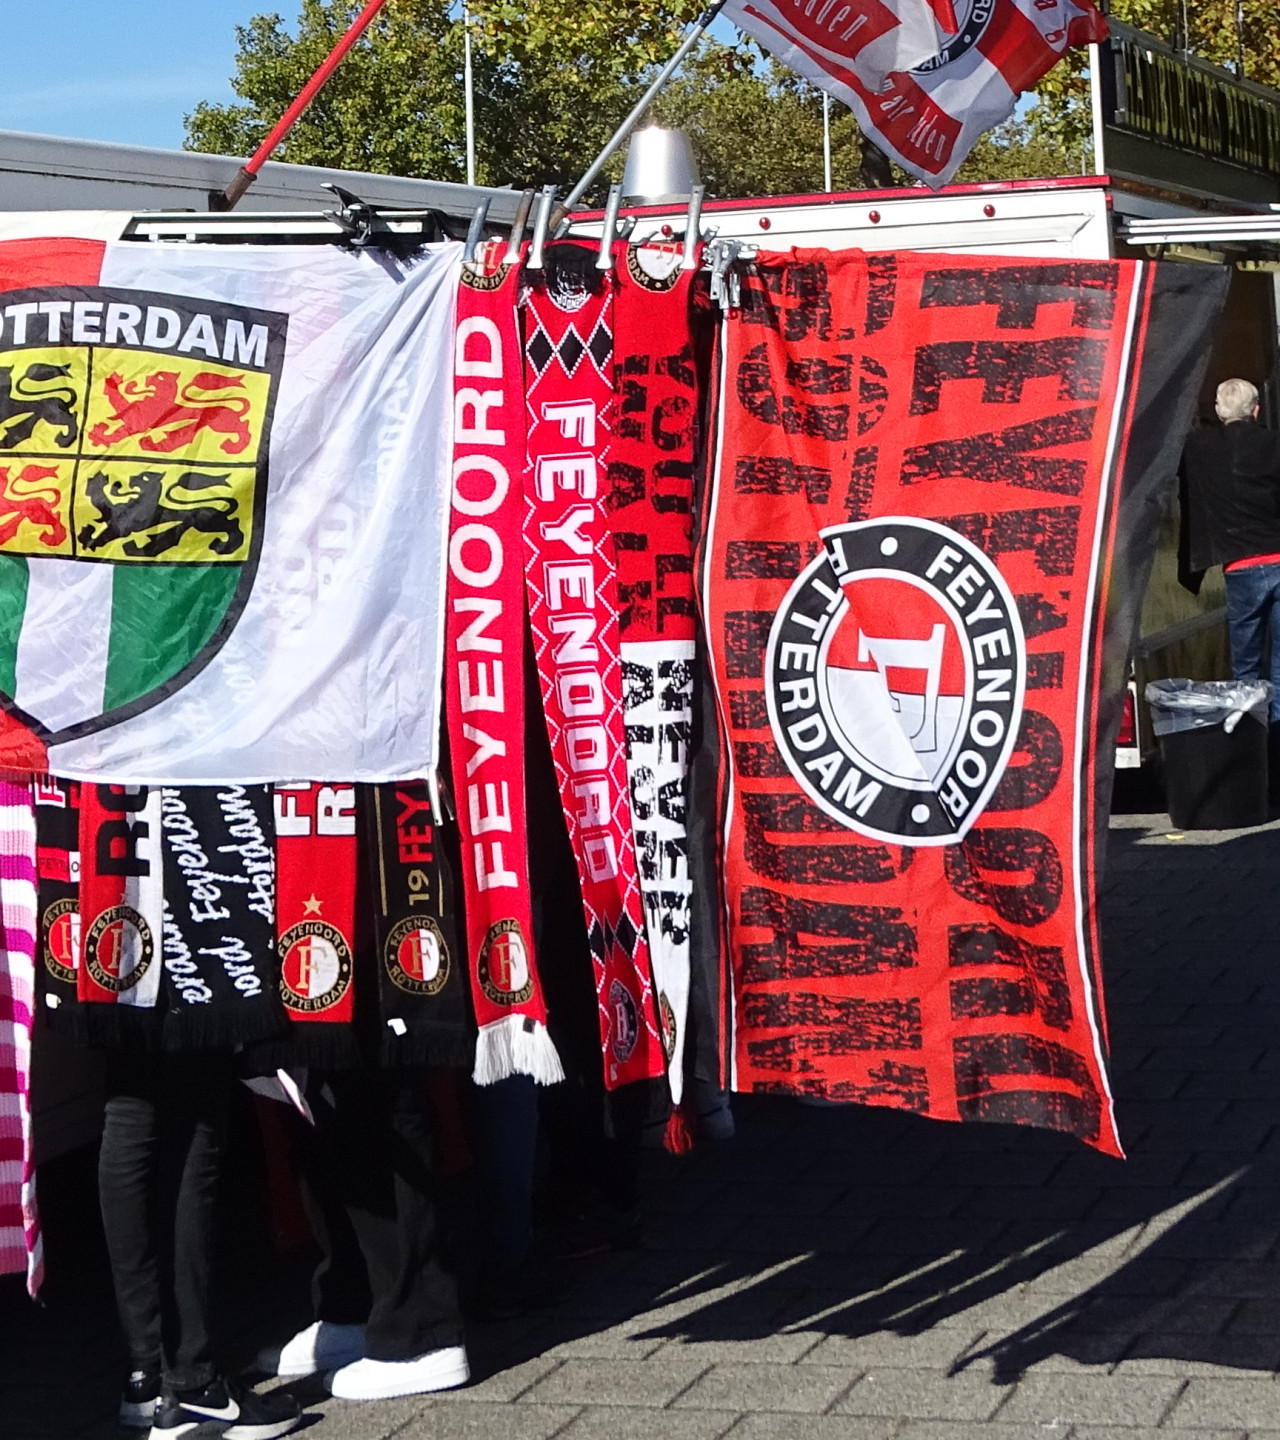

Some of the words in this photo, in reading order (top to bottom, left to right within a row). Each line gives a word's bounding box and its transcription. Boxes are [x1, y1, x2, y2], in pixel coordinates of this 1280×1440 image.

[450, 316, 519, 892] FEYENOORD
[605, 355, 653, 634] WALK
[535, 398, 619, 883] FEYENOORD
[779, 538, 882, 818] RTTERDAM
[925, 545, 1012, 819] FEYENOOR
[279, 922, 347, 958] FEYENOORD
[657, 660, 694, 946] NEVER
[280, 980, 347, 1010] ROTTERDAM
